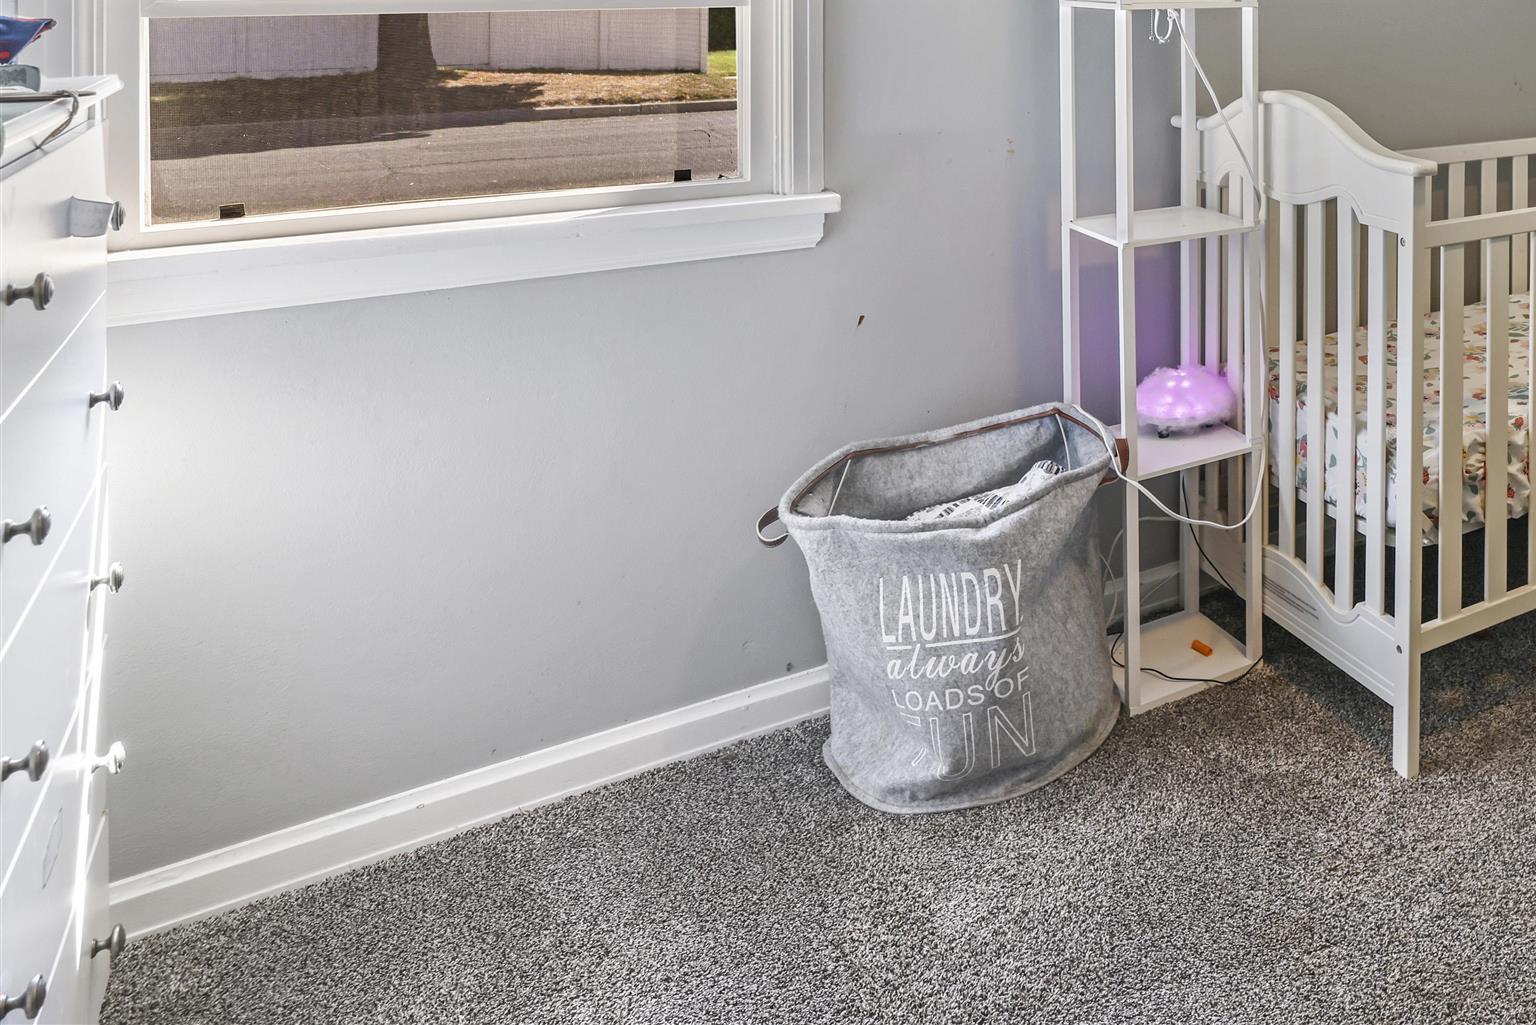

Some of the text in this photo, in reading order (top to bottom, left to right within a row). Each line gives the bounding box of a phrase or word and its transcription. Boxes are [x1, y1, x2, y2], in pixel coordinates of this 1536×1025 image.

[879, 559, 1023, 643] LAUNDRY
[886, 636, 1026, 691] always
[891, 666, 1030, 712] LOADS OF
